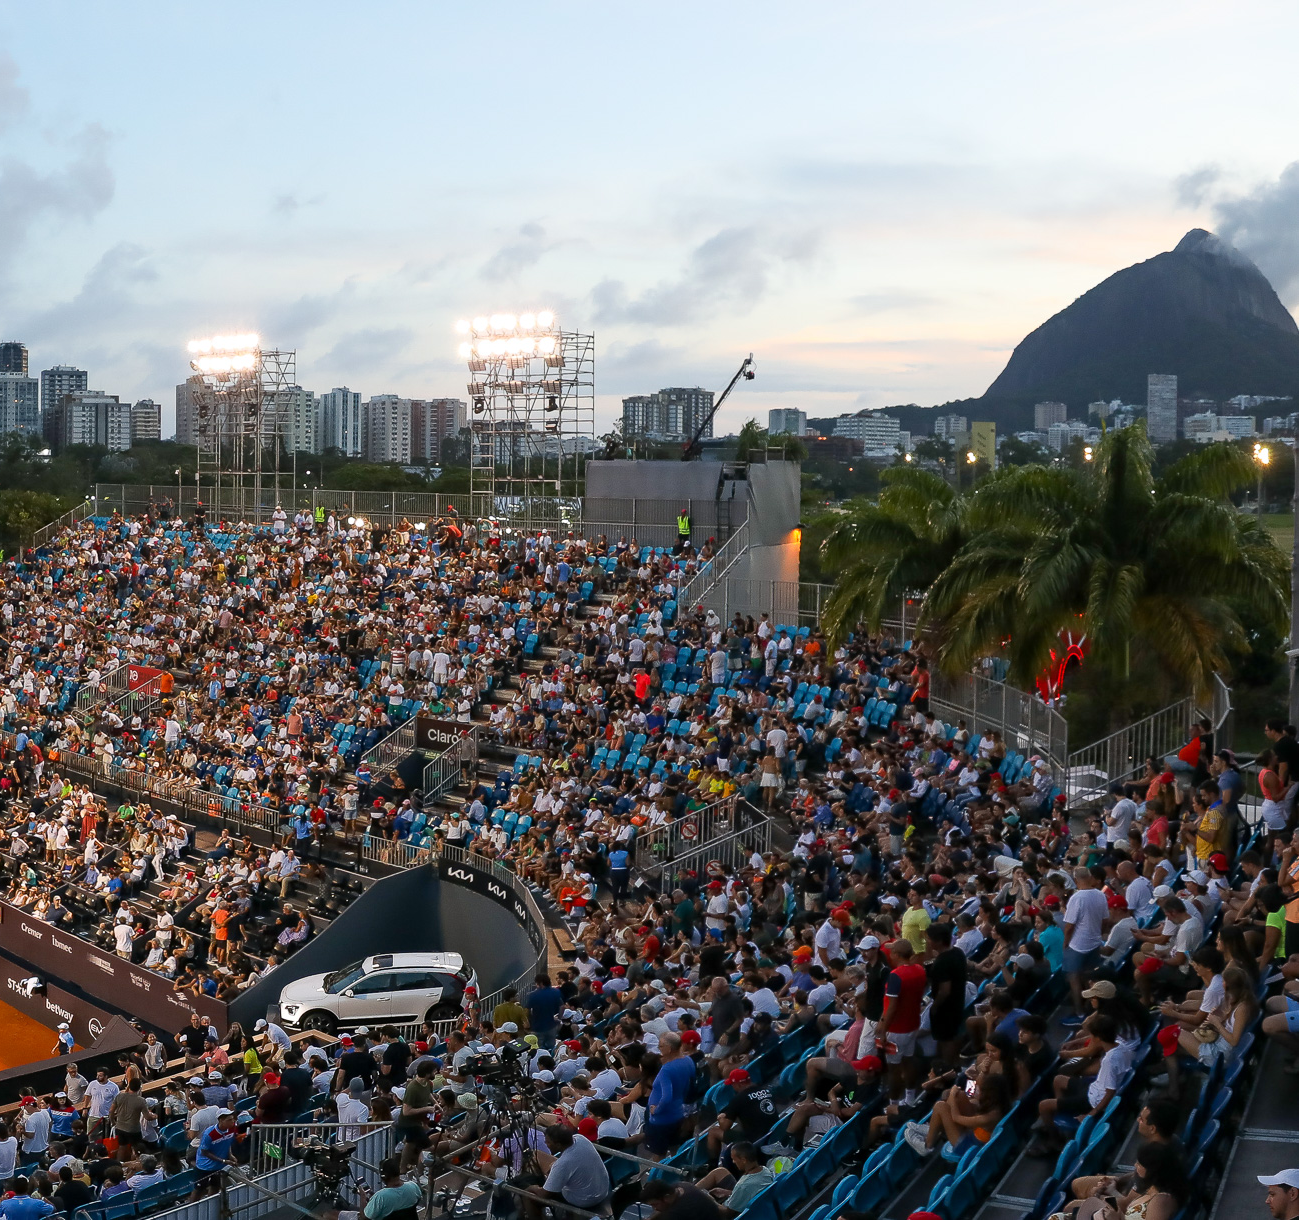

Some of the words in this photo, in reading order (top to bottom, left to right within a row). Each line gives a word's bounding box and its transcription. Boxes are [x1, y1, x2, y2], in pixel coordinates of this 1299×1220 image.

[427, 727, 464, 745] Claro
[20, 922, 44, 940] Cremer
[51, 934, 73, 954] ibmec
[45, 998, 75, 1023] betway
